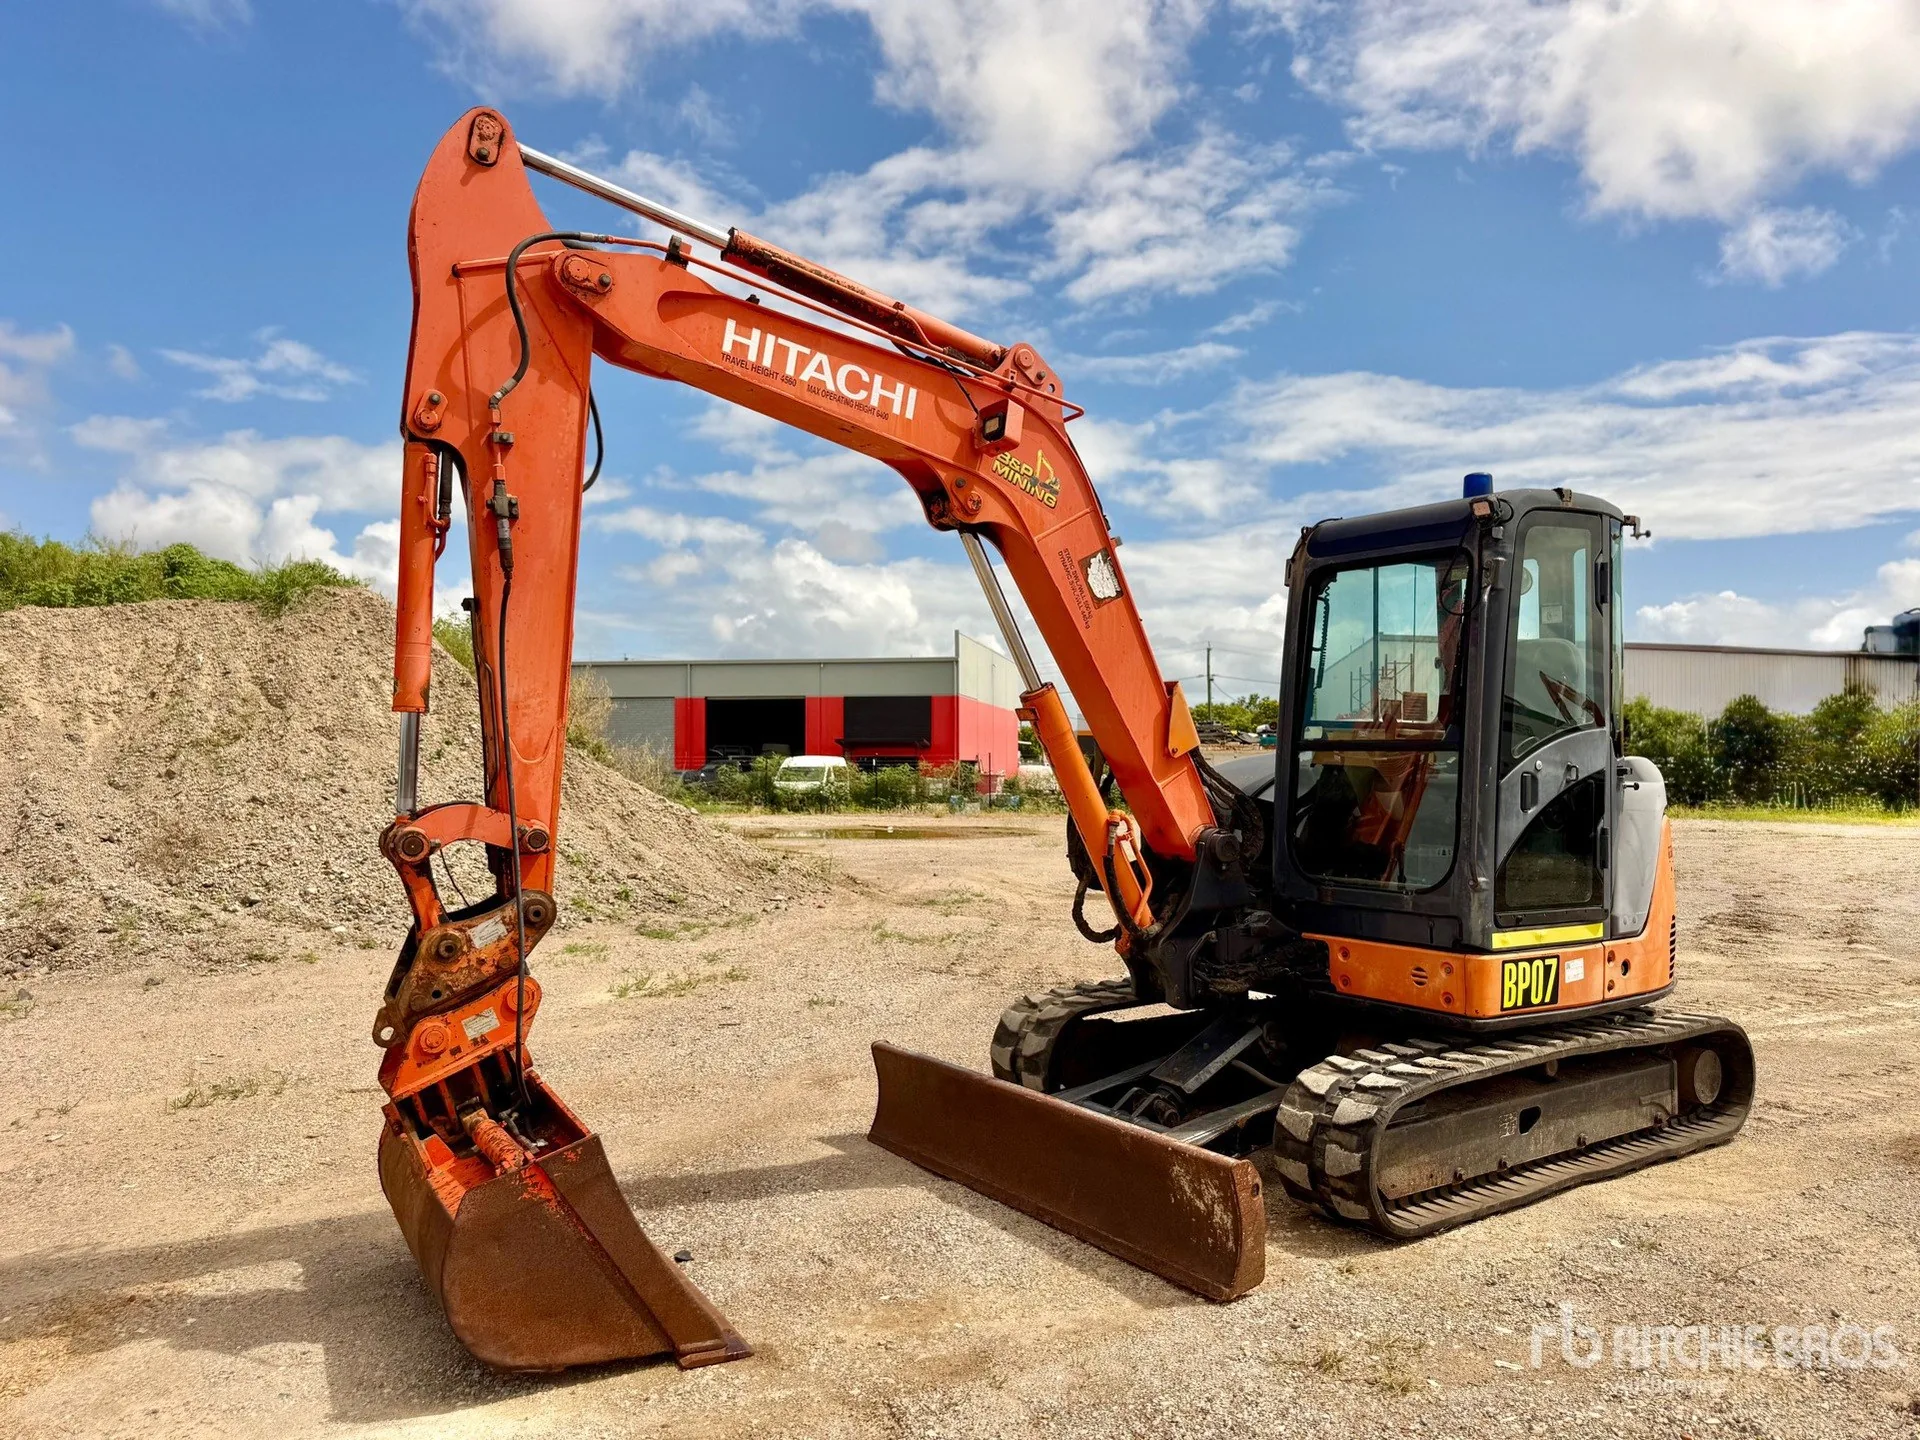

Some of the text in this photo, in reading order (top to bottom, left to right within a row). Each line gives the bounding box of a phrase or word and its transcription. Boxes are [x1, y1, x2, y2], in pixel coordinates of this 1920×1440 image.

[721, 352, 750, 371] TRAVEL
[751, 363, 780, 381] HEIGHT
[721, 318, 918, 421] HITACHI
[806, 384, 821, 397] MAX
[820, 389, 854, 409] OPERATING
[854, 401, 877, 417] HEIGHT
[991, 460, 1058, 509] MINING
[1057, 550, 1073, 581] DYNAMIC
[1502, 957, 1558, 1009] BP07
